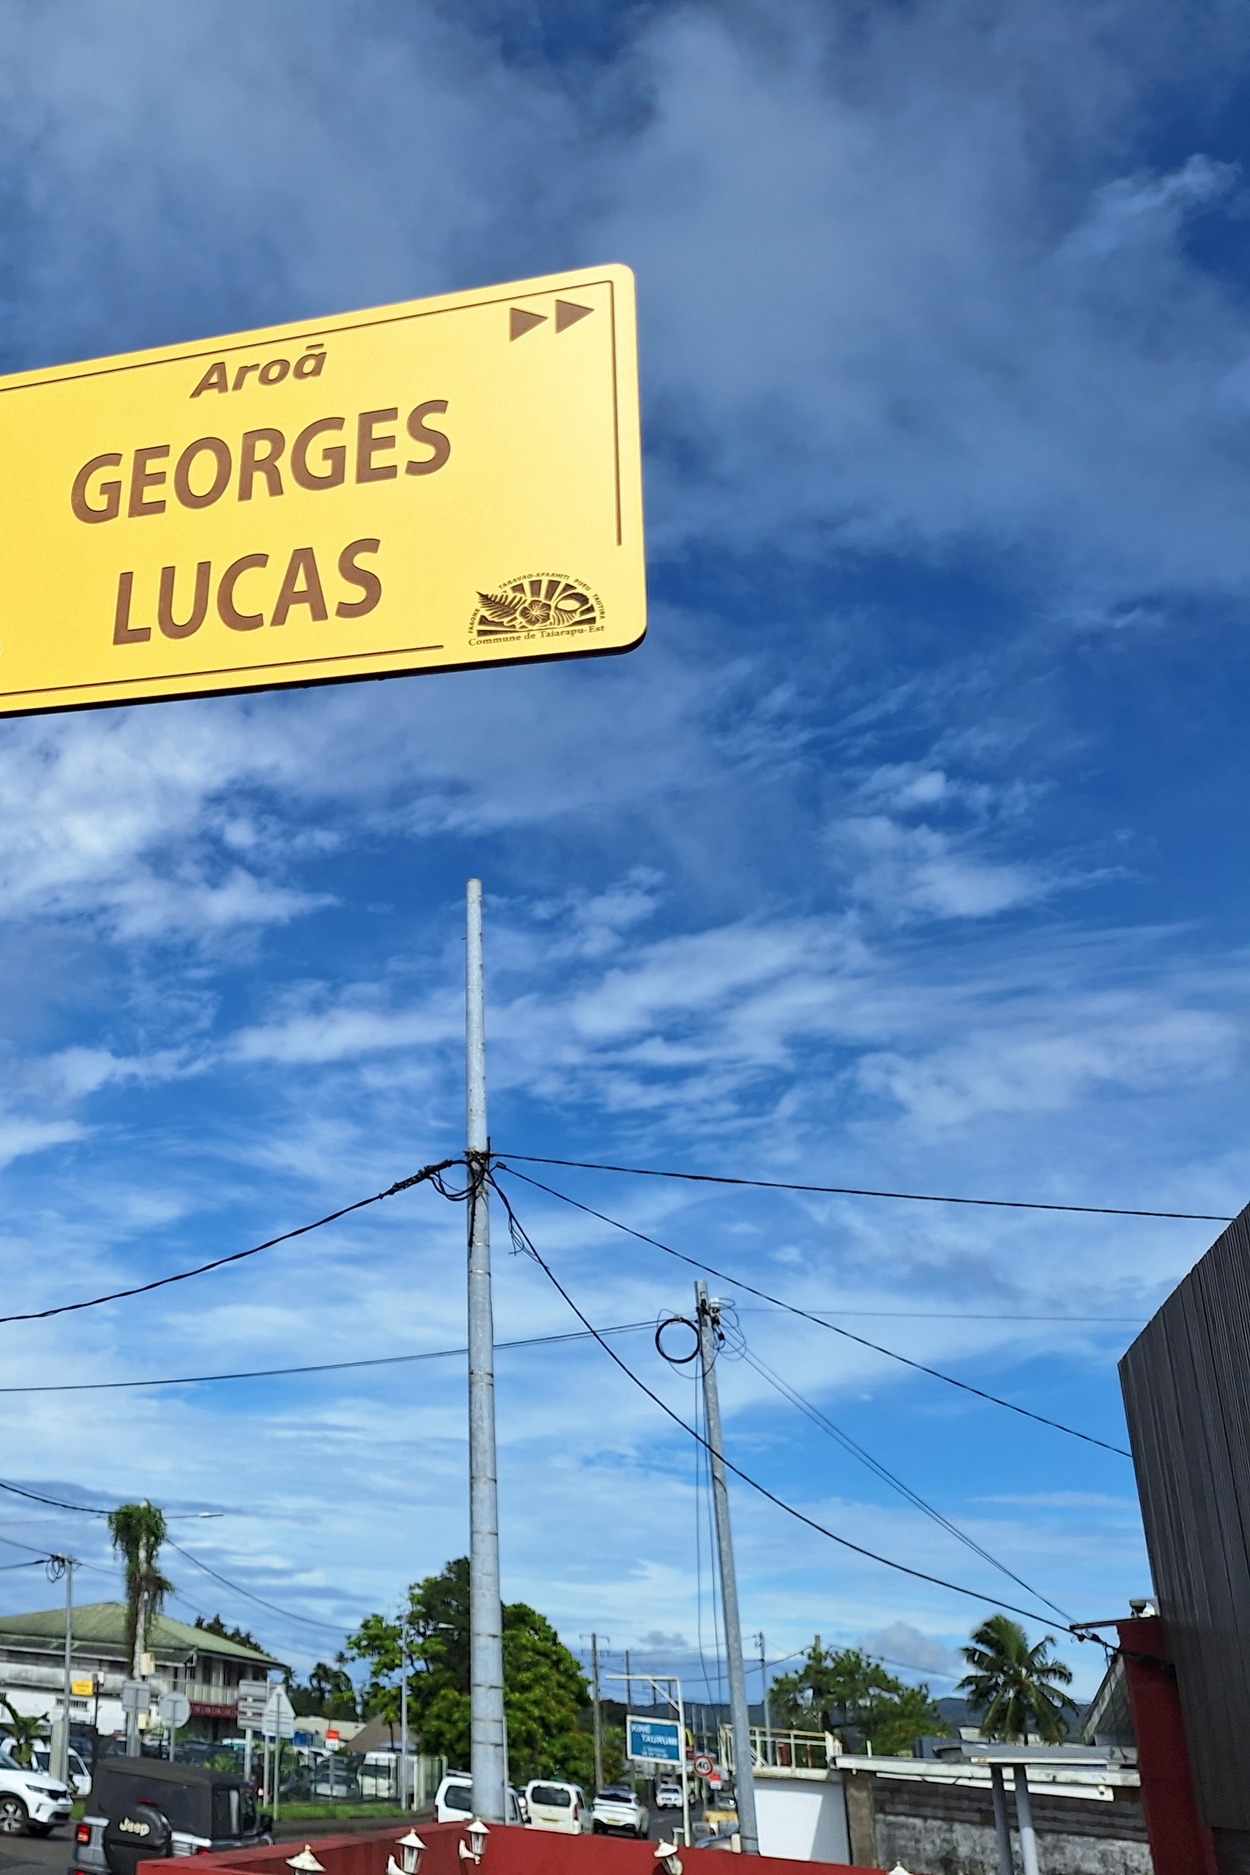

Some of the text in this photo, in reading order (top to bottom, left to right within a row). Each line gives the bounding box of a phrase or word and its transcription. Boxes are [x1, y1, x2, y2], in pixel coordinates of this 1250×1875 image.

[189, 343, 327, 398] Aroā
[70, 399, 451, 524] GEORGES
[112, 538, 383, 645] LUCAS
[468, 625, 605, 646] Commune de Taiarapu-Est
[119, 1816, 150, 1837] Jeep
